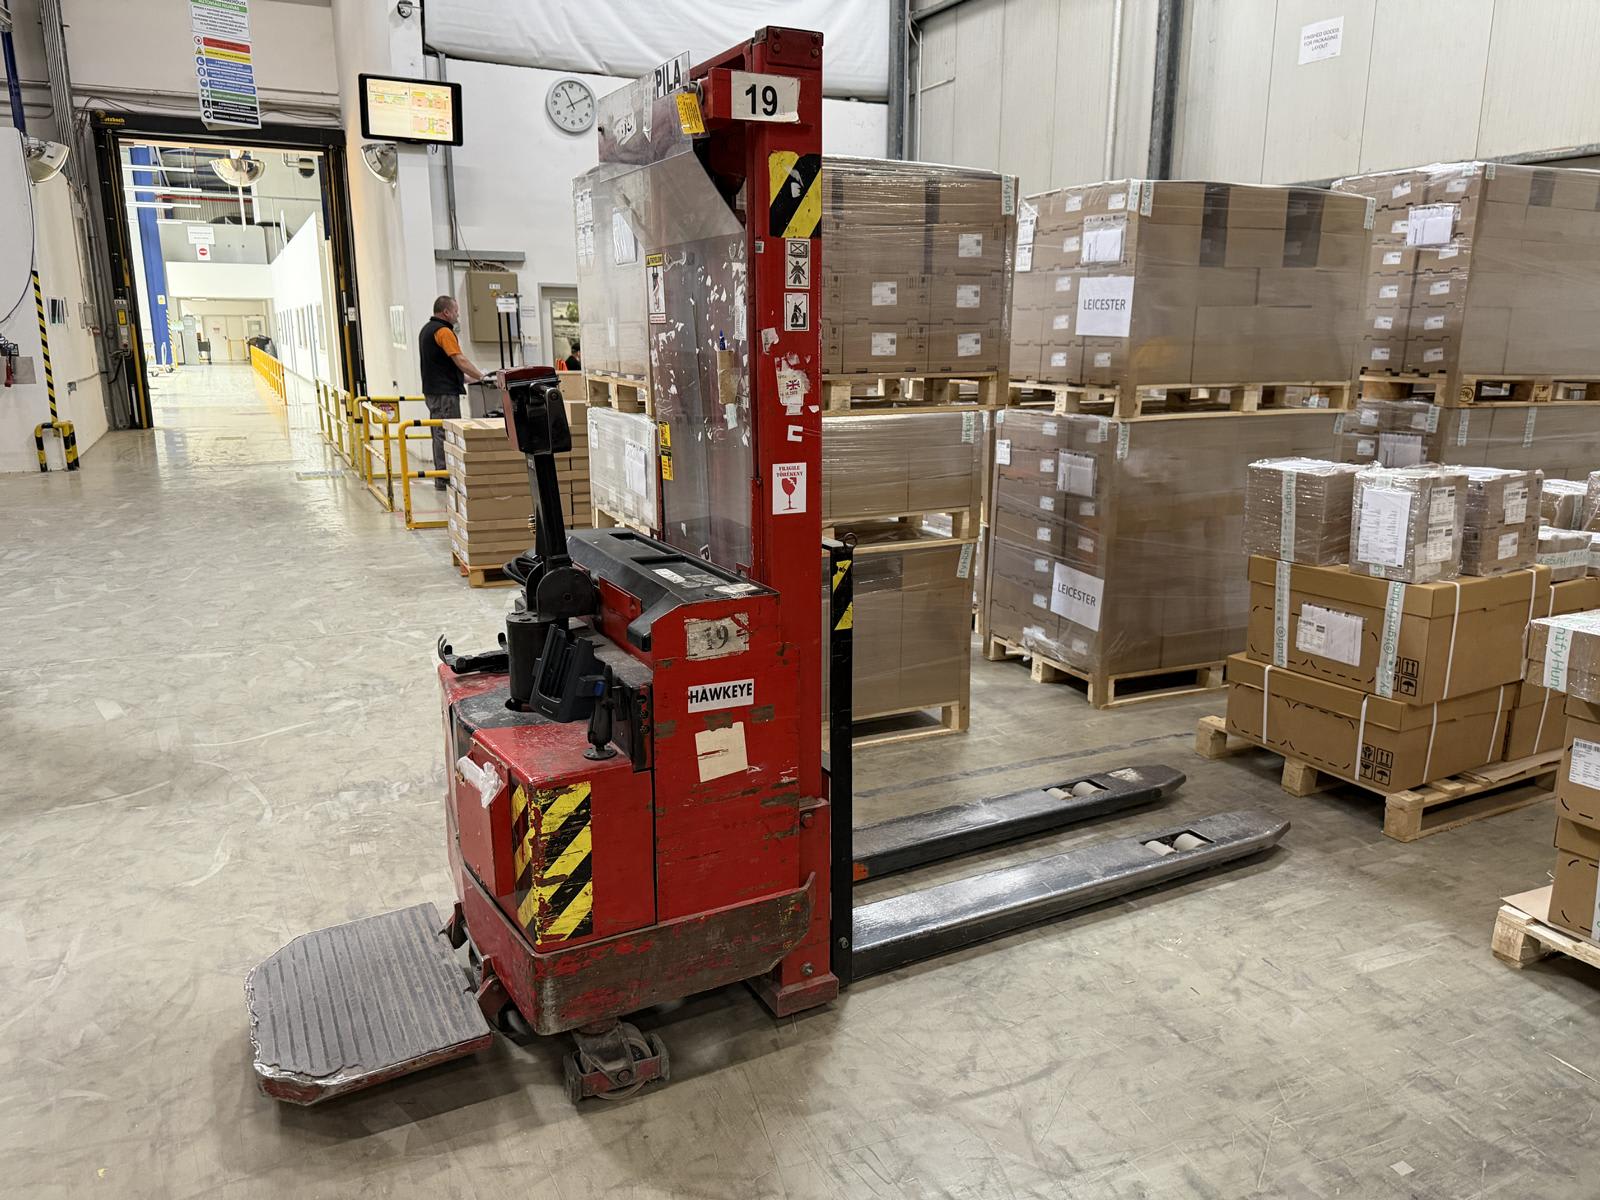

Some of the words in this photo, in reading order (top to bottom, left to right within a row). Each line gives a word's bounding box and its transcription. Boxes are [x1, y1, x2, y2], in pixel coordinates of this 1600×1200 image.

[654, 59, 681, 98] PILA
[745, 84, 778, 116] 19
[1083, 298, 1126, 311] LEICESTER
[1058, 582, 1096, 607] LEICESTER
[704, 624, 728, 650] 19
[1550, 658, 1565, 691] Hun
[690, 682, 752, 704] HAWKEYE
